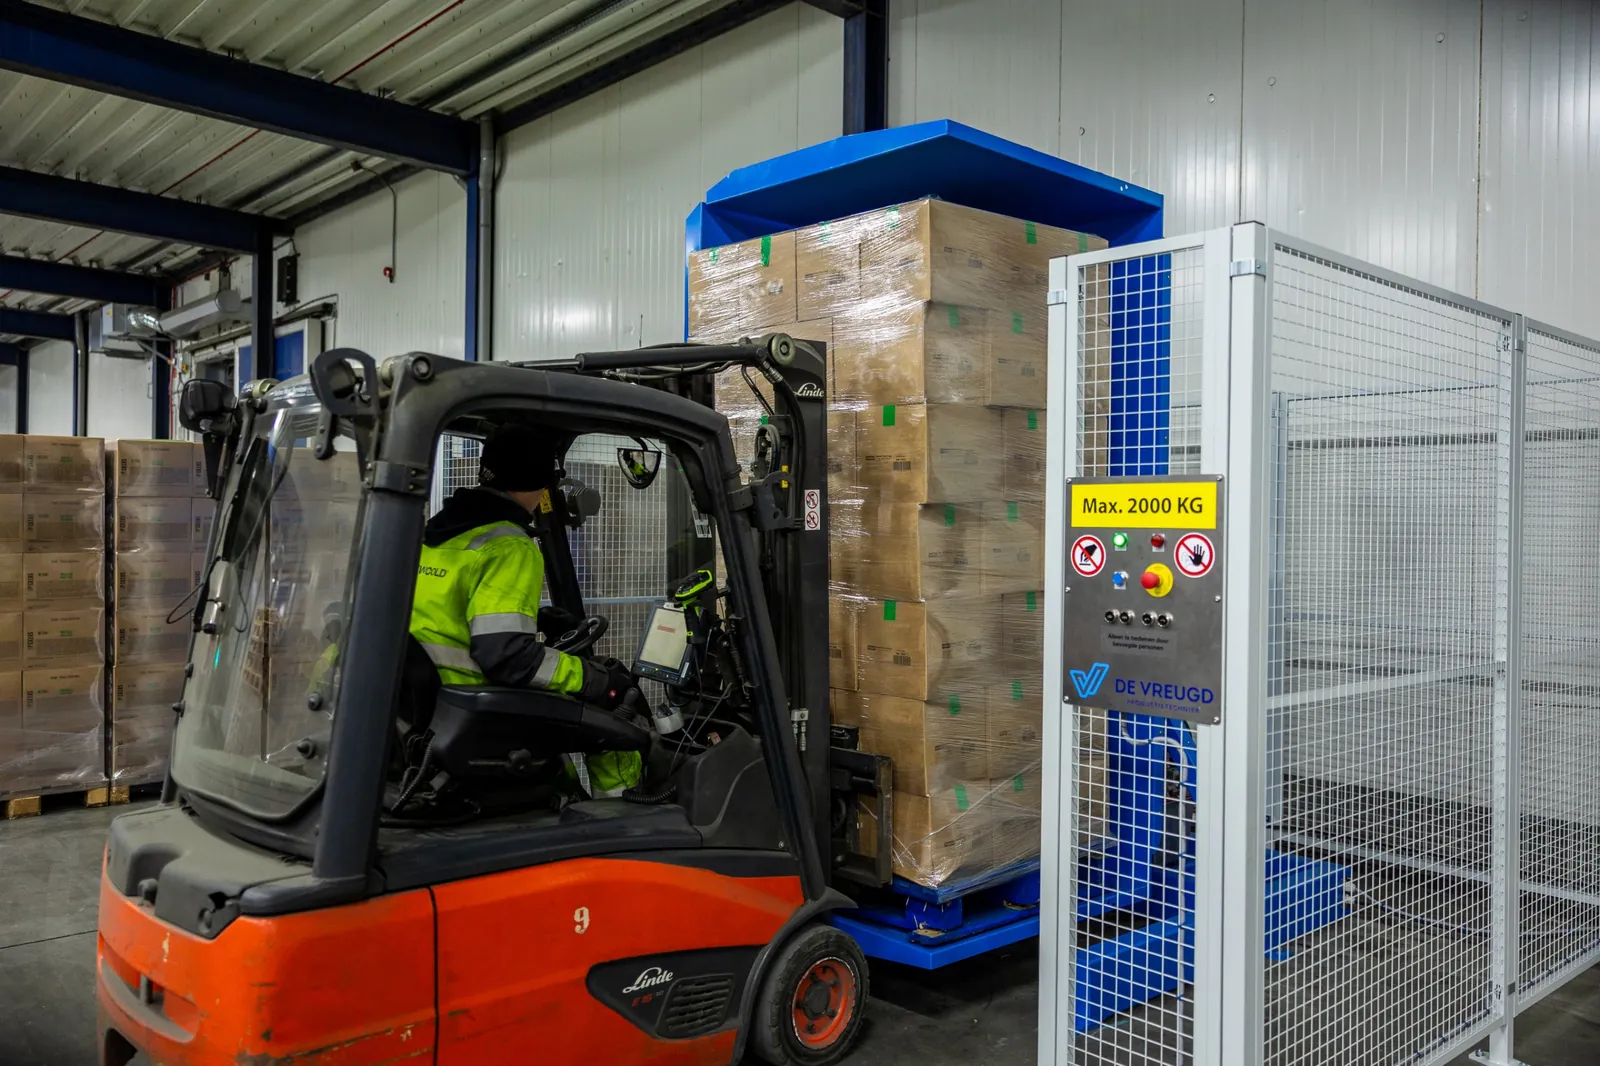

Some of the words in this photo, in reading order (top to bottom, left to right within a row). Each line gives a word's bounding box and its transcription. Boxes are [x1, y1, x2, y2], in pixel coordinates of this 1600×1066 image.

[793, 382, 824, 397] Linde
[1083, 498, 1122, 514] Max.
[1127, 498, 1171, 514] 2000
[1178, 497, 1203, 514] KG
[1115, 678, 1136, 695] DE
[1140, 681, 1214, 704] VREUGD
[1126, 699, 1200, 714] PRODUCTIETECHNIEK
[574, 906, 589, 934] 9
[622, 966, 673, 993] Linde
